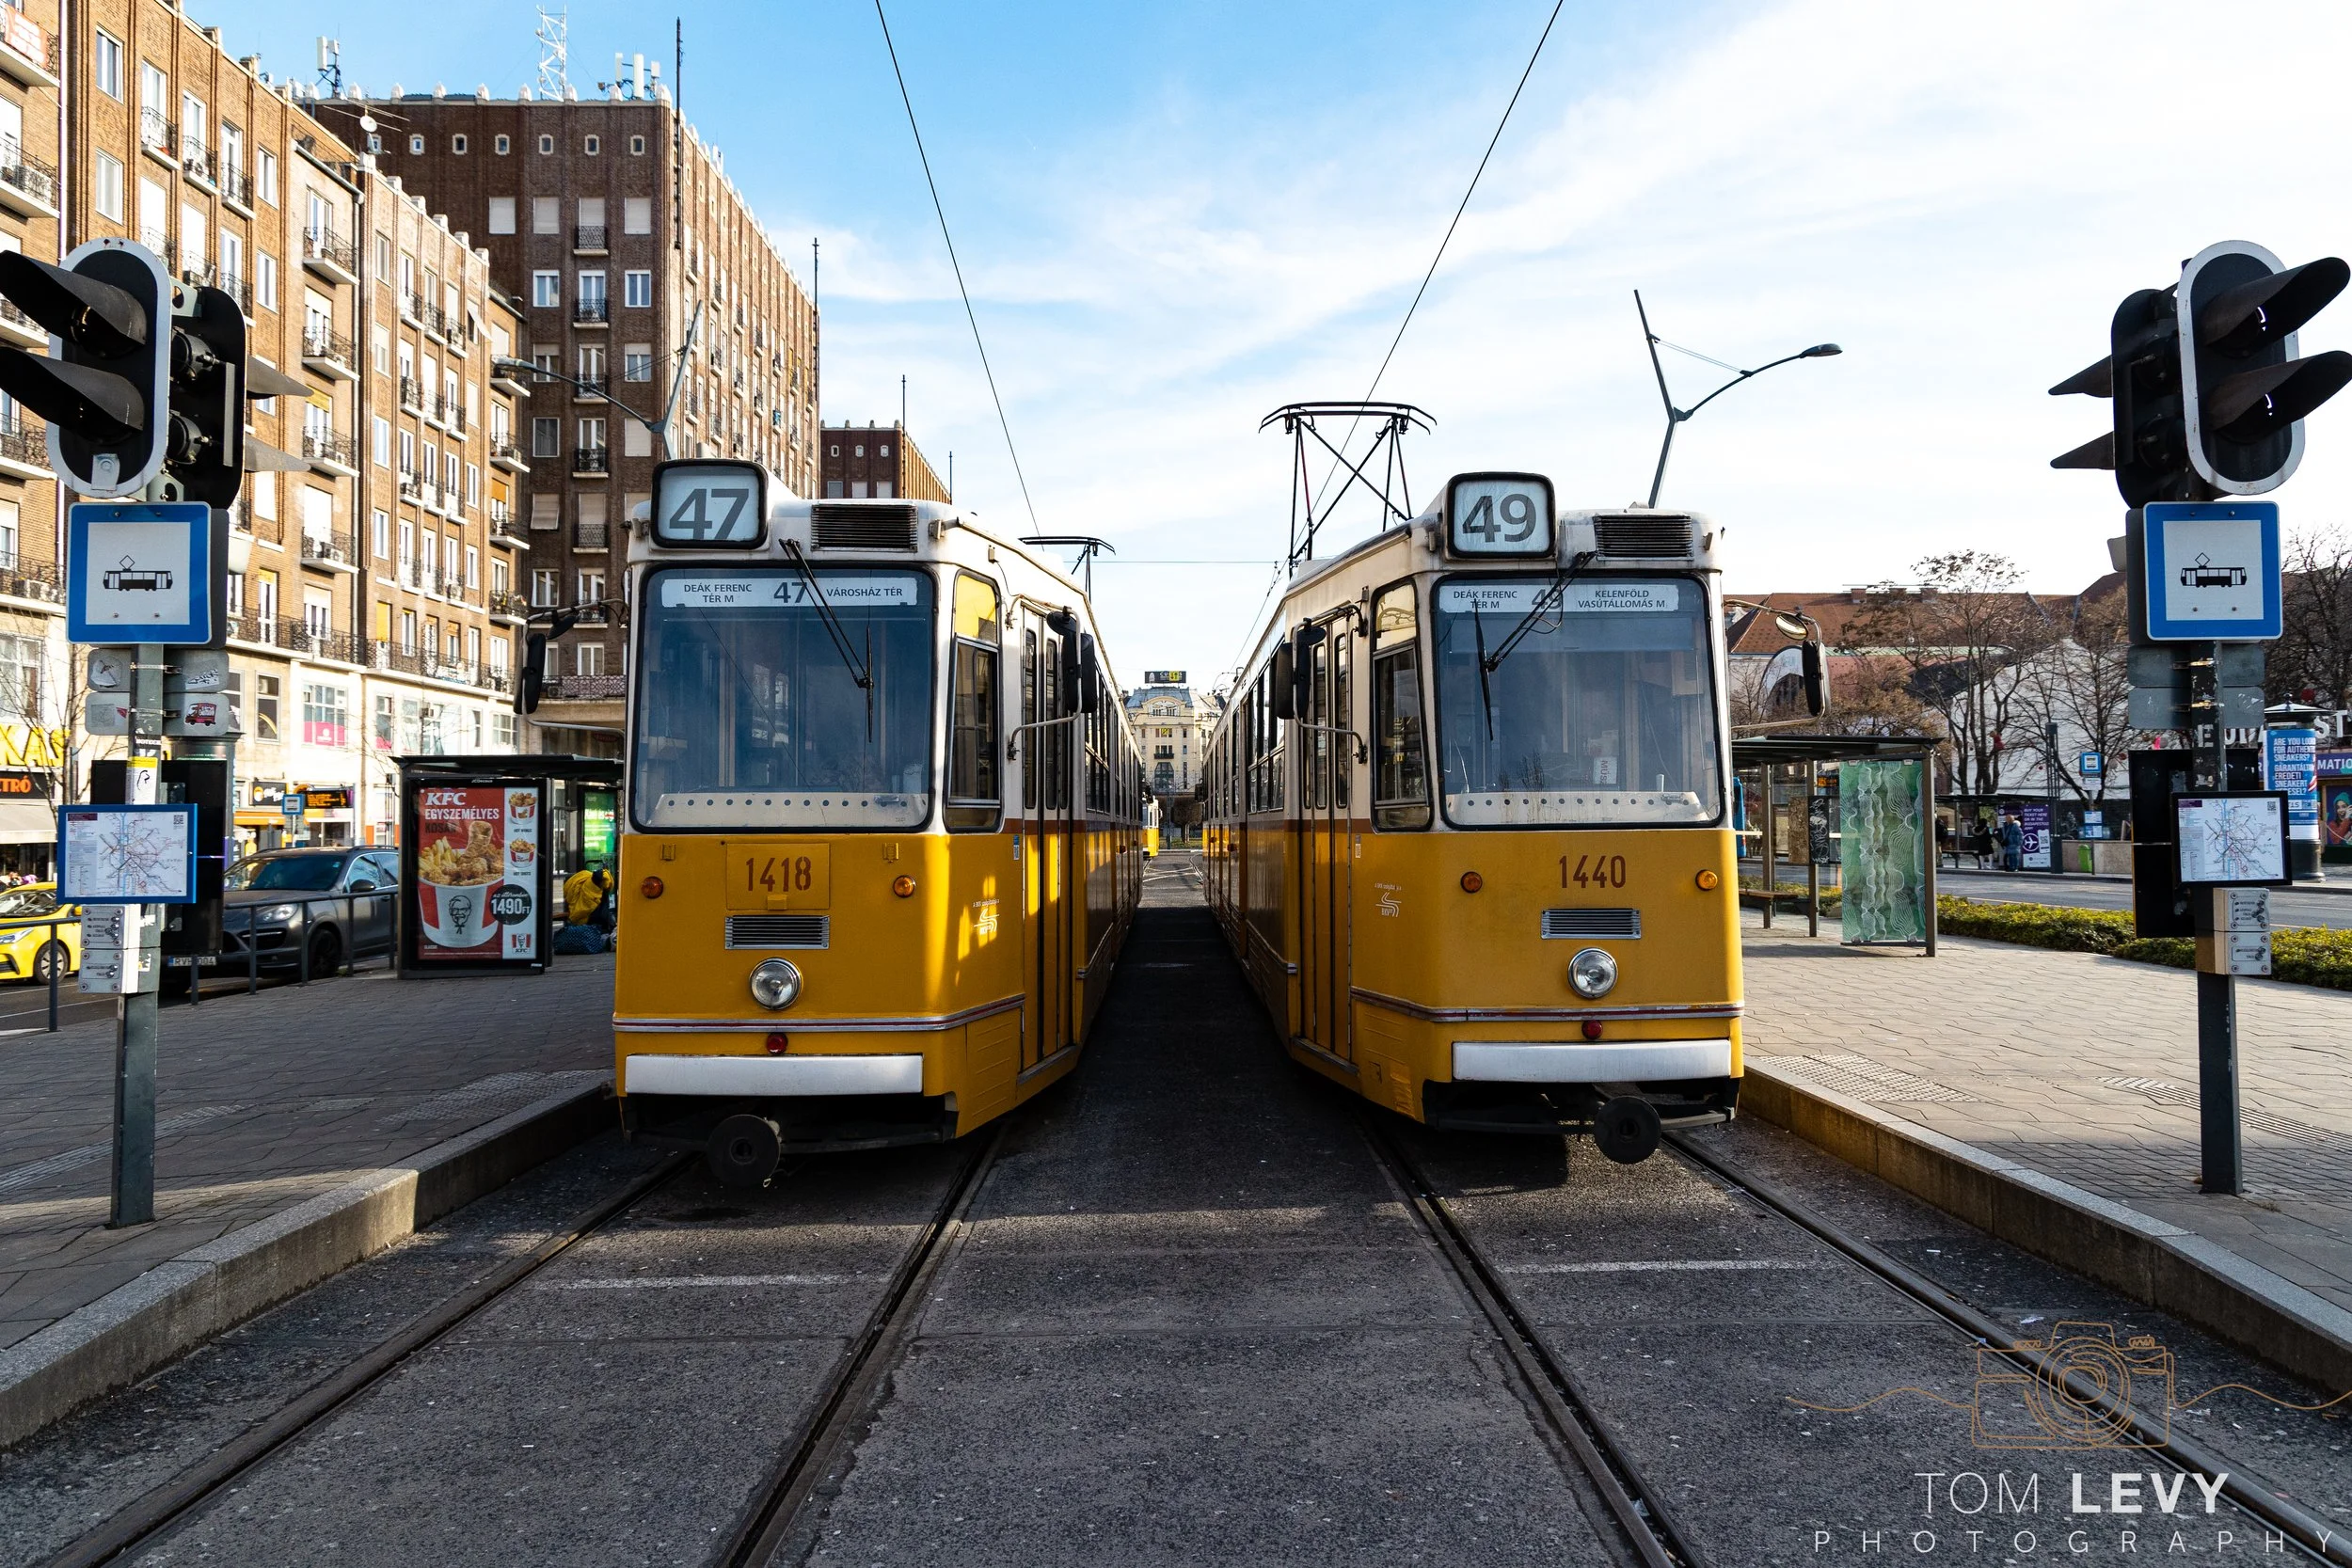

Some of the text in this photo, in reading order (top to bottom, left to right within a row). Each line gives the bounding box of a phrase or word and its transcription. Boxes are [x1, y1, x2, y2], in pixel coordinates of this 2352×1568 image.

[669, 488, 750, 541] 47
[1462, 493, 1537, 543] 49
[683, 582, 753, 593] DEÁK FERENC
[773, 581, 807, 604] 47
[826, 586, 903, 597] VÁROSHÁZ TÉR
[1595, 588, 1649, 598] KELENFÖLD
[703, 593, 734, 603] TÉR M
[1453, 589, 1518, 599] DEÁK FERENC
[1531, 589, 1562, 610] 49
[1470, 598, 1500, 609] TÉR M
[1578, 598, 1665, 609] VASÚTÁLLOMÁS M
[2274, 771, 2302, 780] EREDETI
[425, 792, 467, 806] KFC
[424, 805, 500, 820] EGYSZEMÉLYES
[746, 856, 812, 893] 1418
[1559, 854, 1626, 889] 1440
